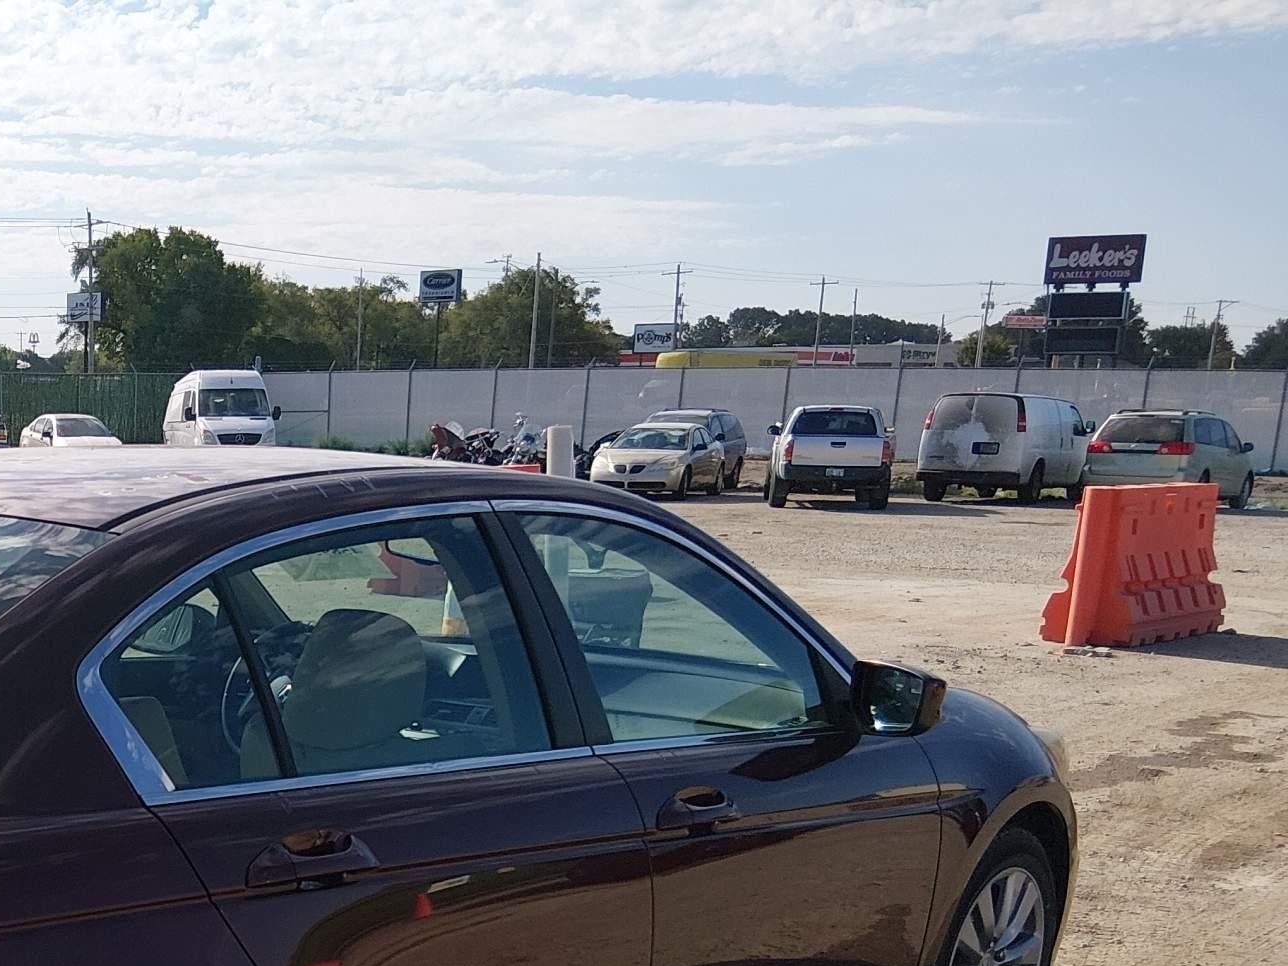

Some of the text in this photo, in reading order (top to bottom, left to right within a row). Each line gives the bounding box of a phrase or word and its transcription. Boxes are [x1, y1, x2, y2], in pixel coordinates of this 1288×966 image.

[1049, 242, 1138, 268] Leeker's
[1052, 269, 1131, 279] FAMILY FOODS
